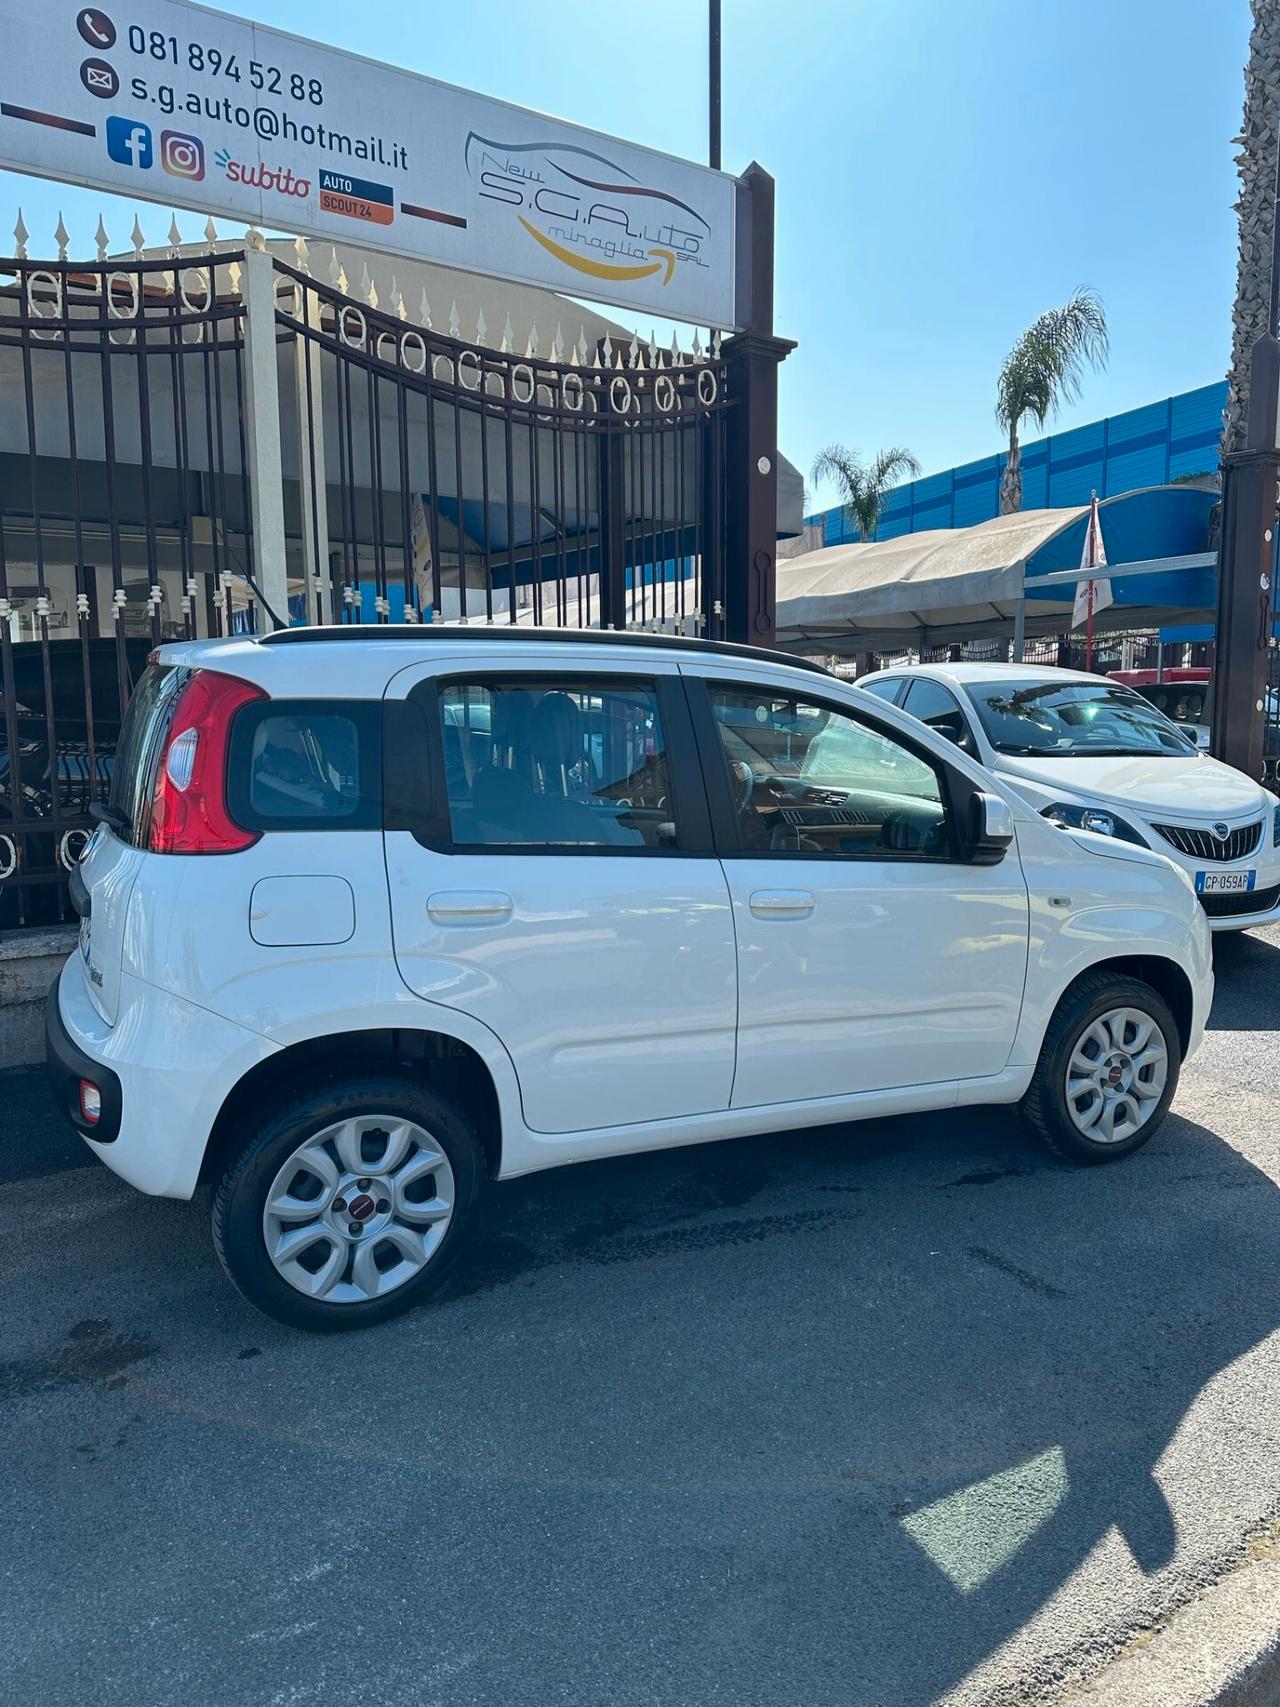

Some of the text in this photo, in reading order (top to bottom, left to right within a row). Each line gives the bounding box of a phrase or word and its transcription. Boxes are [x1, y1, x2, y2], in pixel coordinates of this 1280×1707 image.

[128, 25, 323, 105] 081 894 52 88
[131, 78, 408, 171] s.g.auto@hotmail.it
[225, 161, 311, 198] subito
[323, 174, 352, 193] AUTO
[481, 151, 545, 184] New
[323, 195, 372, 218] SCOUT 24
